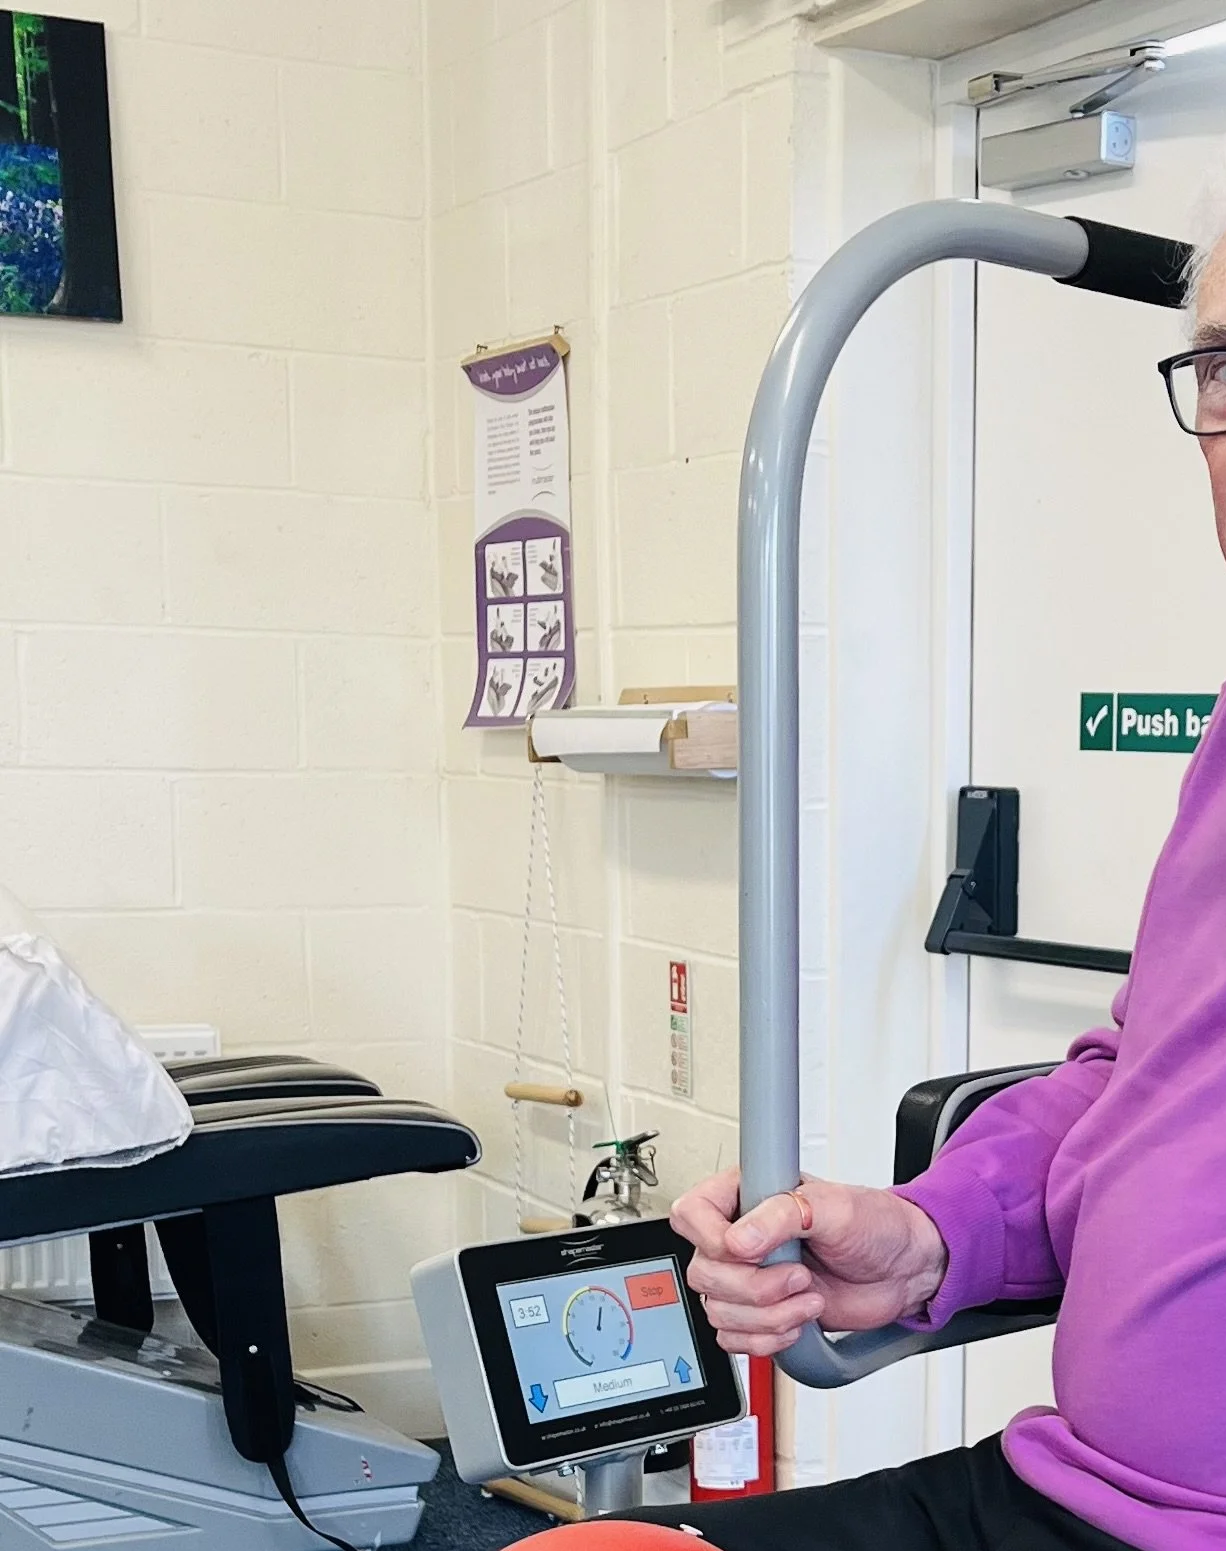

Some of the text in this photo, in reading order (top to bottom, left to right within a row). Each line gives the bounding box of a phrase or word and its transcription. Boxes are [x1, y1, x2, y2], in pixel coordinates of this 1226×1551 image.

[1121, 707, 1179, 736] Push
[641, 1285, 664, 1298] Stop
[518, 1306, 542, 1320] 3:52
[593, 1377, 633, 1394] Medium
